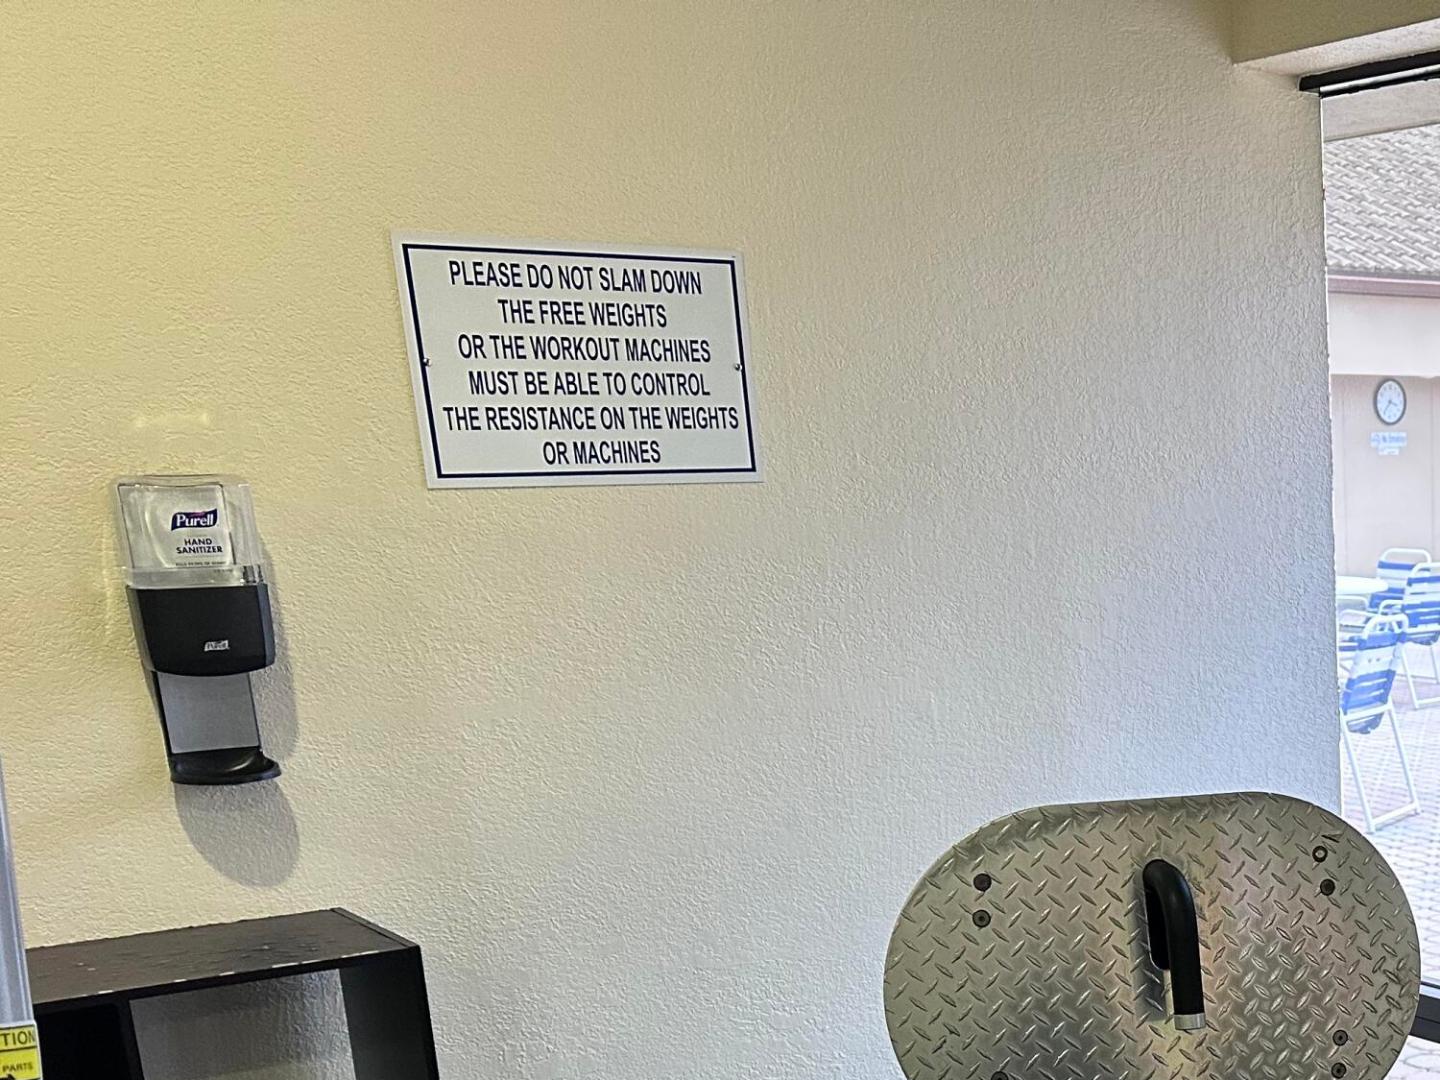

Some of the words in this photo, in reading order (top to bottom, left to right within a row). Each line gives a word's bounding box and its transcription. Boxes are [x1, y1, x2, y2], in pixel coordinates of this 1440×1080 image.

[449, 260, 522, 288] PLEASE
[527, 264, 554, 290] DO
[557, 266, 594, 291] NOT
[599, 268, 646, 293] SLAM
[650, 270, 703, 295] DOWN
[497, 299, 535, 324] THE
[539, 301, 586, 325] FREE
[588, 302, 667, 327] WEIGHTS
[458, 334, 486, 359] OR
[489, 335, 527, 360] THE
[529, 336, 620, 361] WORKOUT
[624, 338, 711, 363] MACHINES
[468, 371, 519, 395] MUST
[526, 372, 550, 395] BE
[554, 372, 600, 396] ABLE
[603, 373, 626, 396] TO
[631, 373, 711, 396] CONTROL
[443, 406, 482, 431] THE
[486, 407, 597, 430] RESISTANCE
[600, 407, 625, 430] ON
[632, 407, 662, 429] THE
[667, 407, 739, 429] WEIGHTS
[542, 441, 569, 465] OR
[573, 440, 661, 464] MACHINES
[176, 513, 214, 527] Purell
[176, 545, 223, 555] SANITIZER
[184, 538, 212, 546] HAND
[2, 1062, 33, 1072] PARTS
